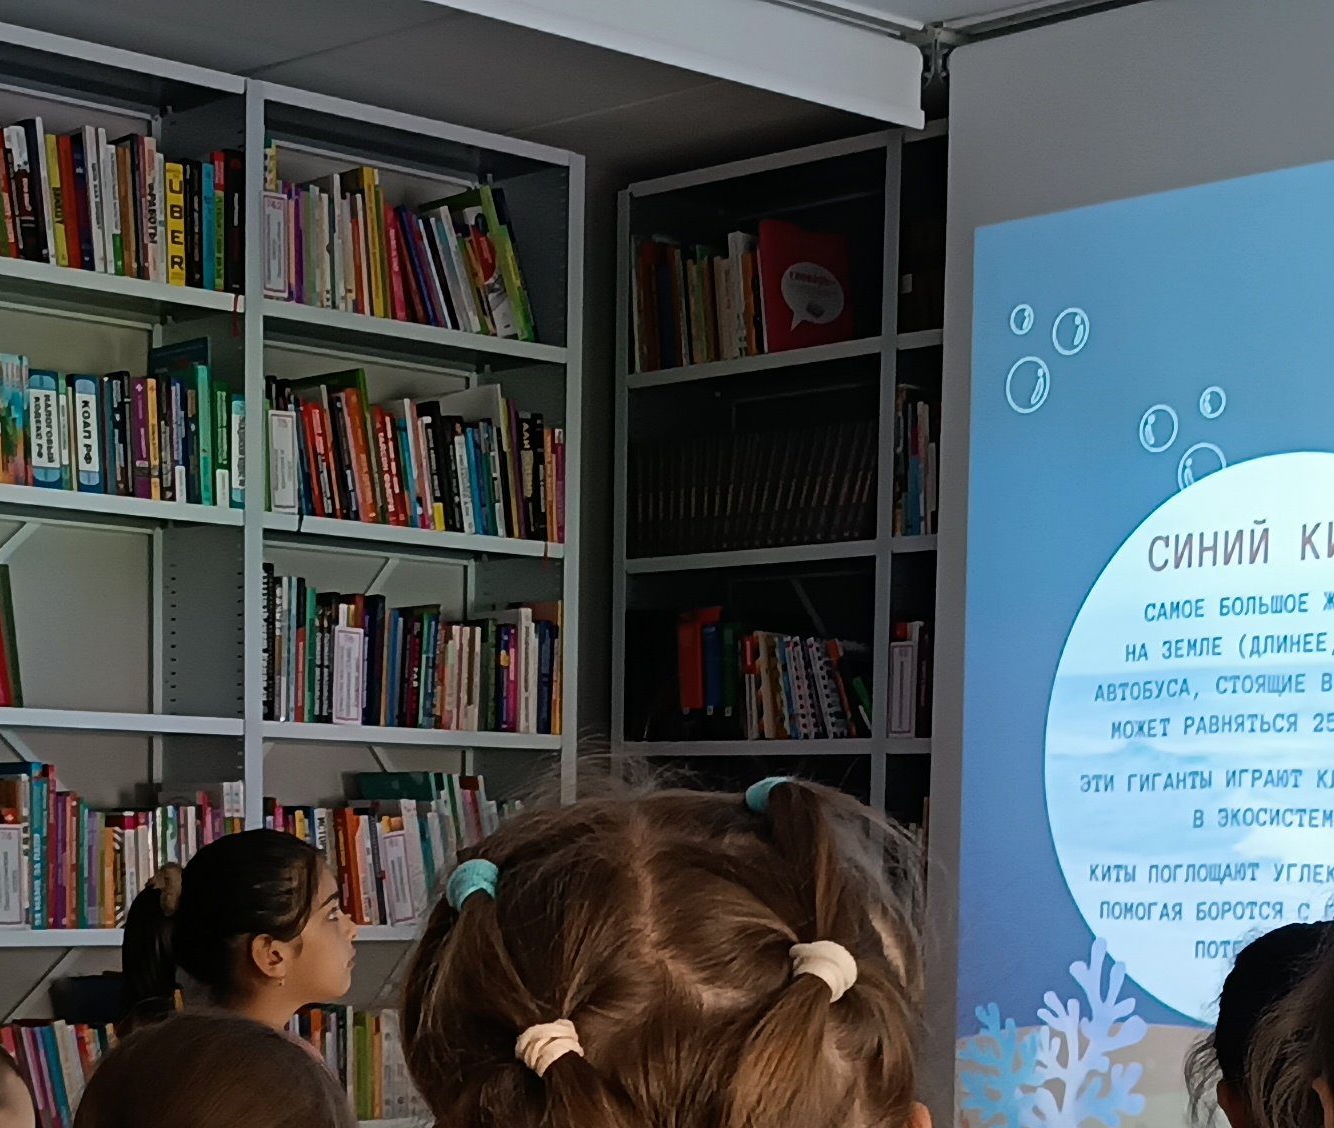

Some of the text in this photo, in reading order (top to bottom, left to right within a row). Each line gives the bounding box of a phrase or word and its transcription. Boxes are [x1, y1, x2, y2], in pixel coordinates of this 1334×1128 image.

[169, 178, 183, 271] UBER
[81, 400, 94, 465] КОАП РФ
[1148, 519, 1269, 571] СИНИЙ
[1145, 599, 1204, 622] САМОЕ
[1220, 593, 1309, 616] БОЛЬШОЕ
[1126, 643, 1148, 661] НА
[1162, 637, 1222, 659] ЗЕМЛЕ
[1095, 678, 1198, 701] АВТОБУСА,
[1216, 674, 1305, 695] СТОЯЩИЕ
[1321, 673, 1332, 692] В
[1112, 718, 1170, 738] МОЖЕТ
[1184, 713, 1297, 735] РАВНЯТЬСЯ
[1081, 775, 1114, 792] ЭТИ
[1128, 771, 1212, 792] ГИГАНТЫ
[1226, 769, 1302, 788] ИГРАЮТ
[1193, 810, 1204, 828] В
[1090, 864, 1136, 882] КИТЫ
[1149, 862, 1259, 884] ПОГЛОЩАЮТ
[1100, 901, 1182, 920] ПОМОГАЯ
[1196, 901, 1283, 920] БОРОТСЯ
[1298, 903, 1310, 921] С
[1196, 941, 1241, 960] ПОТЕ
